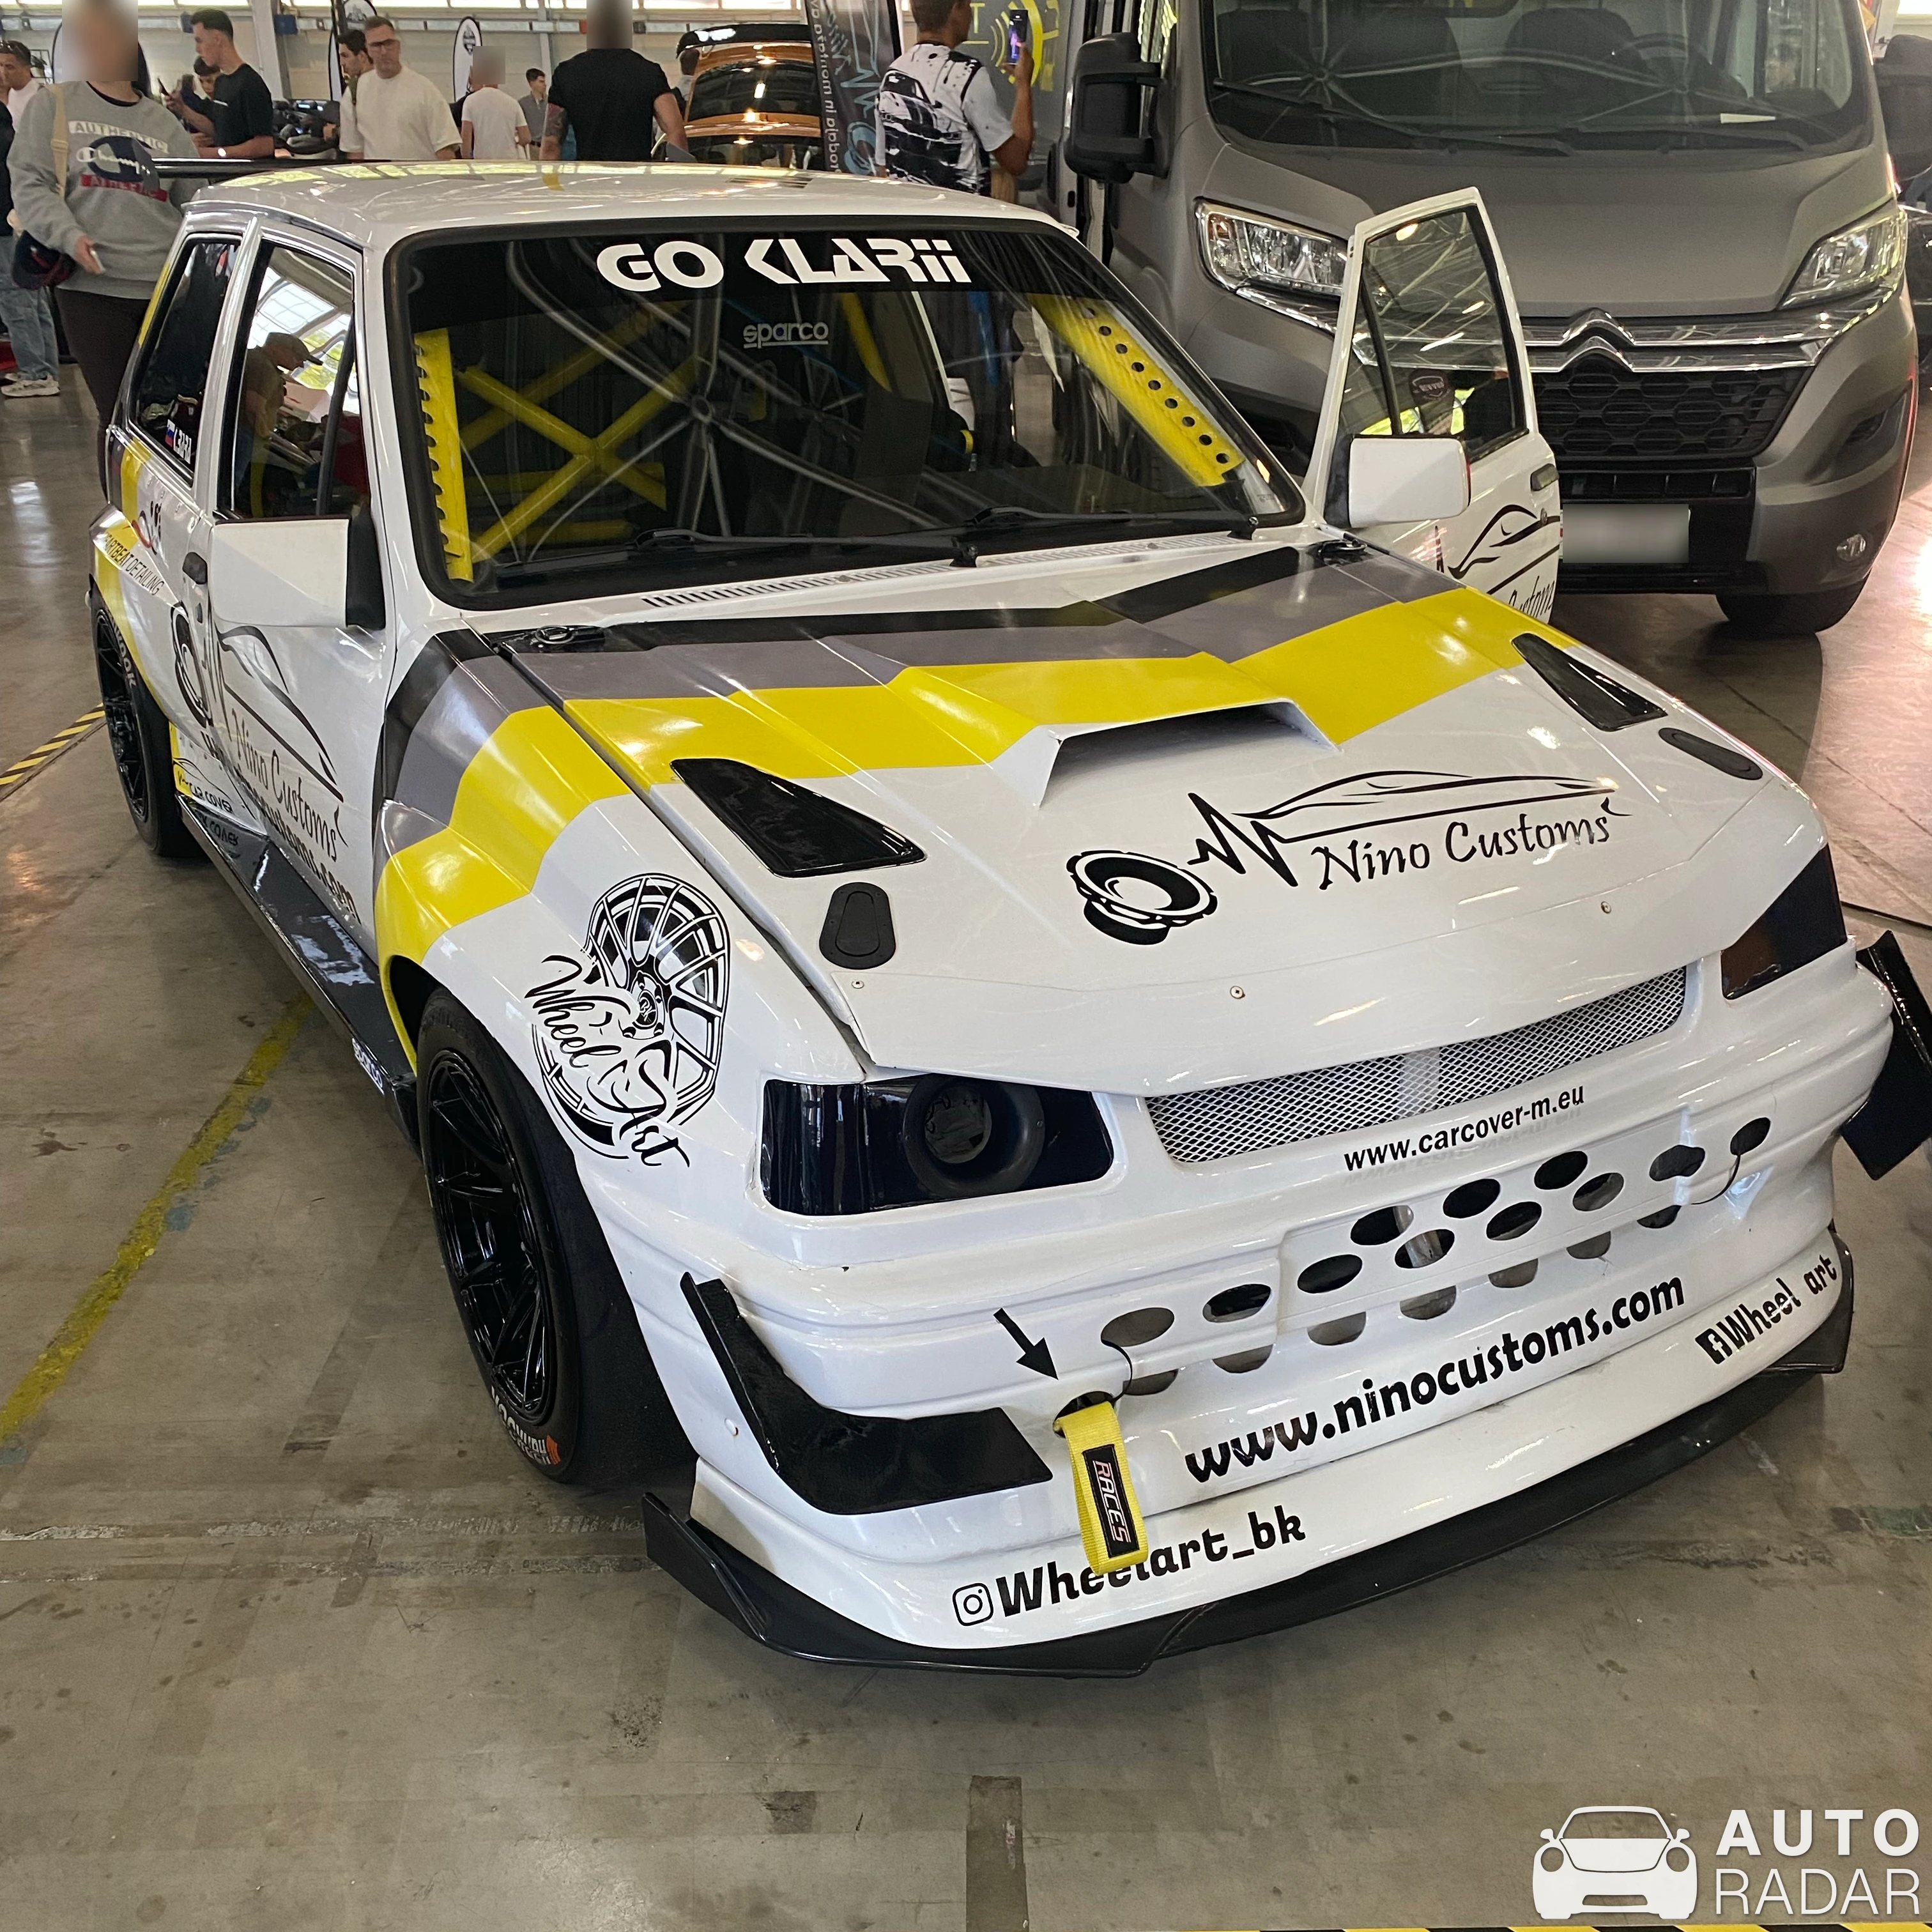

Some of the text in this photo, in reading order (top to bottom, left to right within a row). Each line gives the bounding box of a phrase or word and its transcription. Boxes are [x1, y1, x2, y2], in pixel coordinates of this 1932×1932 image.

[596, 240, 724, 292] GO
[743, 322, 829, 349] sparco
[125, 558, 165, 596] DETAILING
[231, 707, 337, 863] Nino Customs
[1310, 813, 1609, 891] Nino Customs
[524, 954, 631, 1068] Wheel
[1343, 1085, 1585, 1172] www.carcover-m.eu
[1715, 1277, 1802, 1351] Wheel
[1803, 1254, 1837, 1295] art
[1184, 1276, 1685, 1483] www.ninocustoms.com
[1093, 1460, 1131, 1543] RACES
